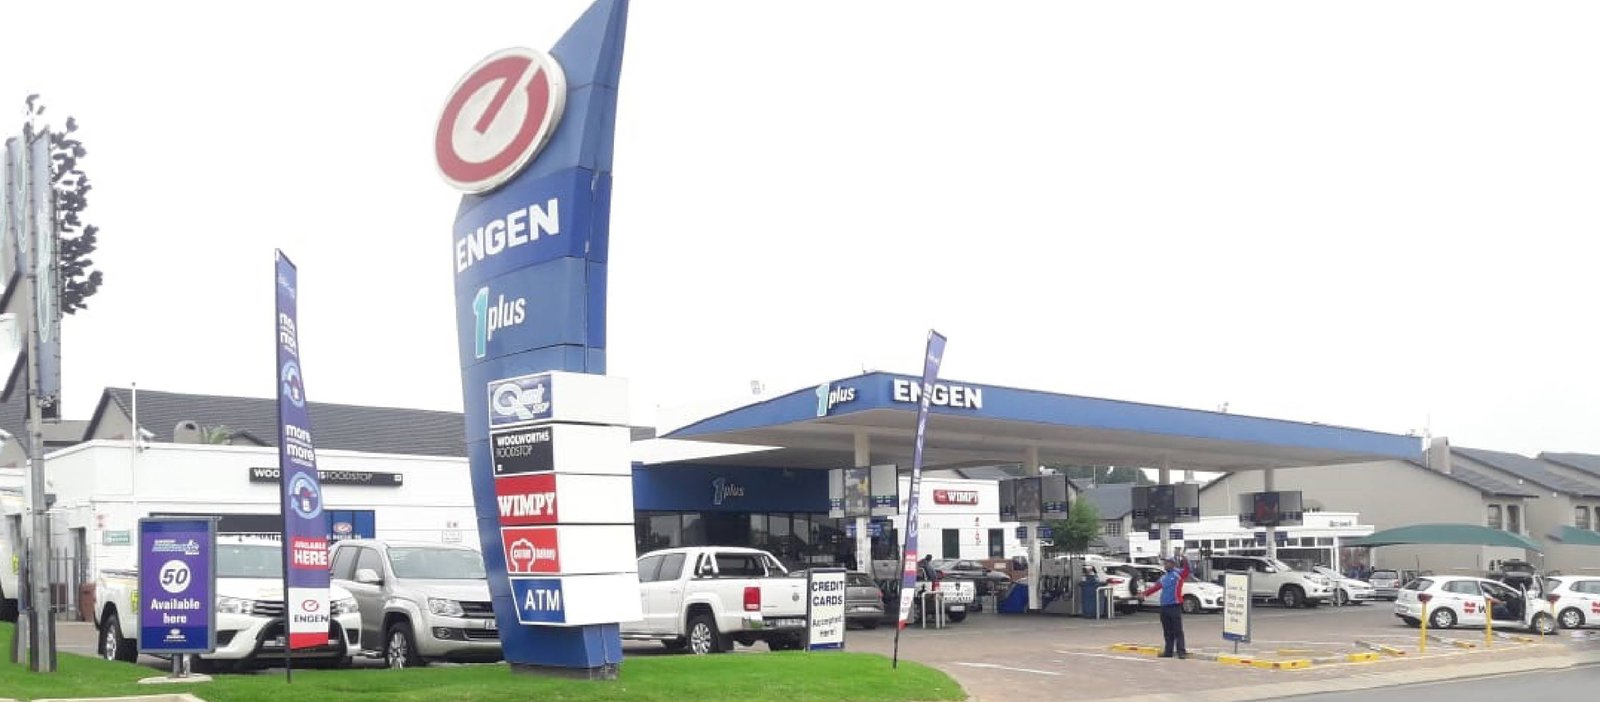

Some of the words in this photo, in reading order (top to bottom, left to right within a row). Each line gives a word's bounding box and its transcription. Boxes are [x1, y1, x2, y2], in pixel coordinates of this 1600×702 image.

[457, 197, 560, 273] ENGEN
[893, 378, 983, 410] ENGEN
[497, 431, 550, 447] WOOLWORTHS
[287, 444, 315, 461] more
[497, 492, 556, 517] WIMPY
[294, 550, 328, 566] HERE
[162, 568, 188, 584] 50
[812, 580, 844, 592] CREDIT
[151, 598, 200, 611] Available
[524, 589, 560, 611] ATM
[812, 595, 843, 607] CARDS
[163, 612, 187, 624] here
[294, 614, 329, 624] ENGEN
